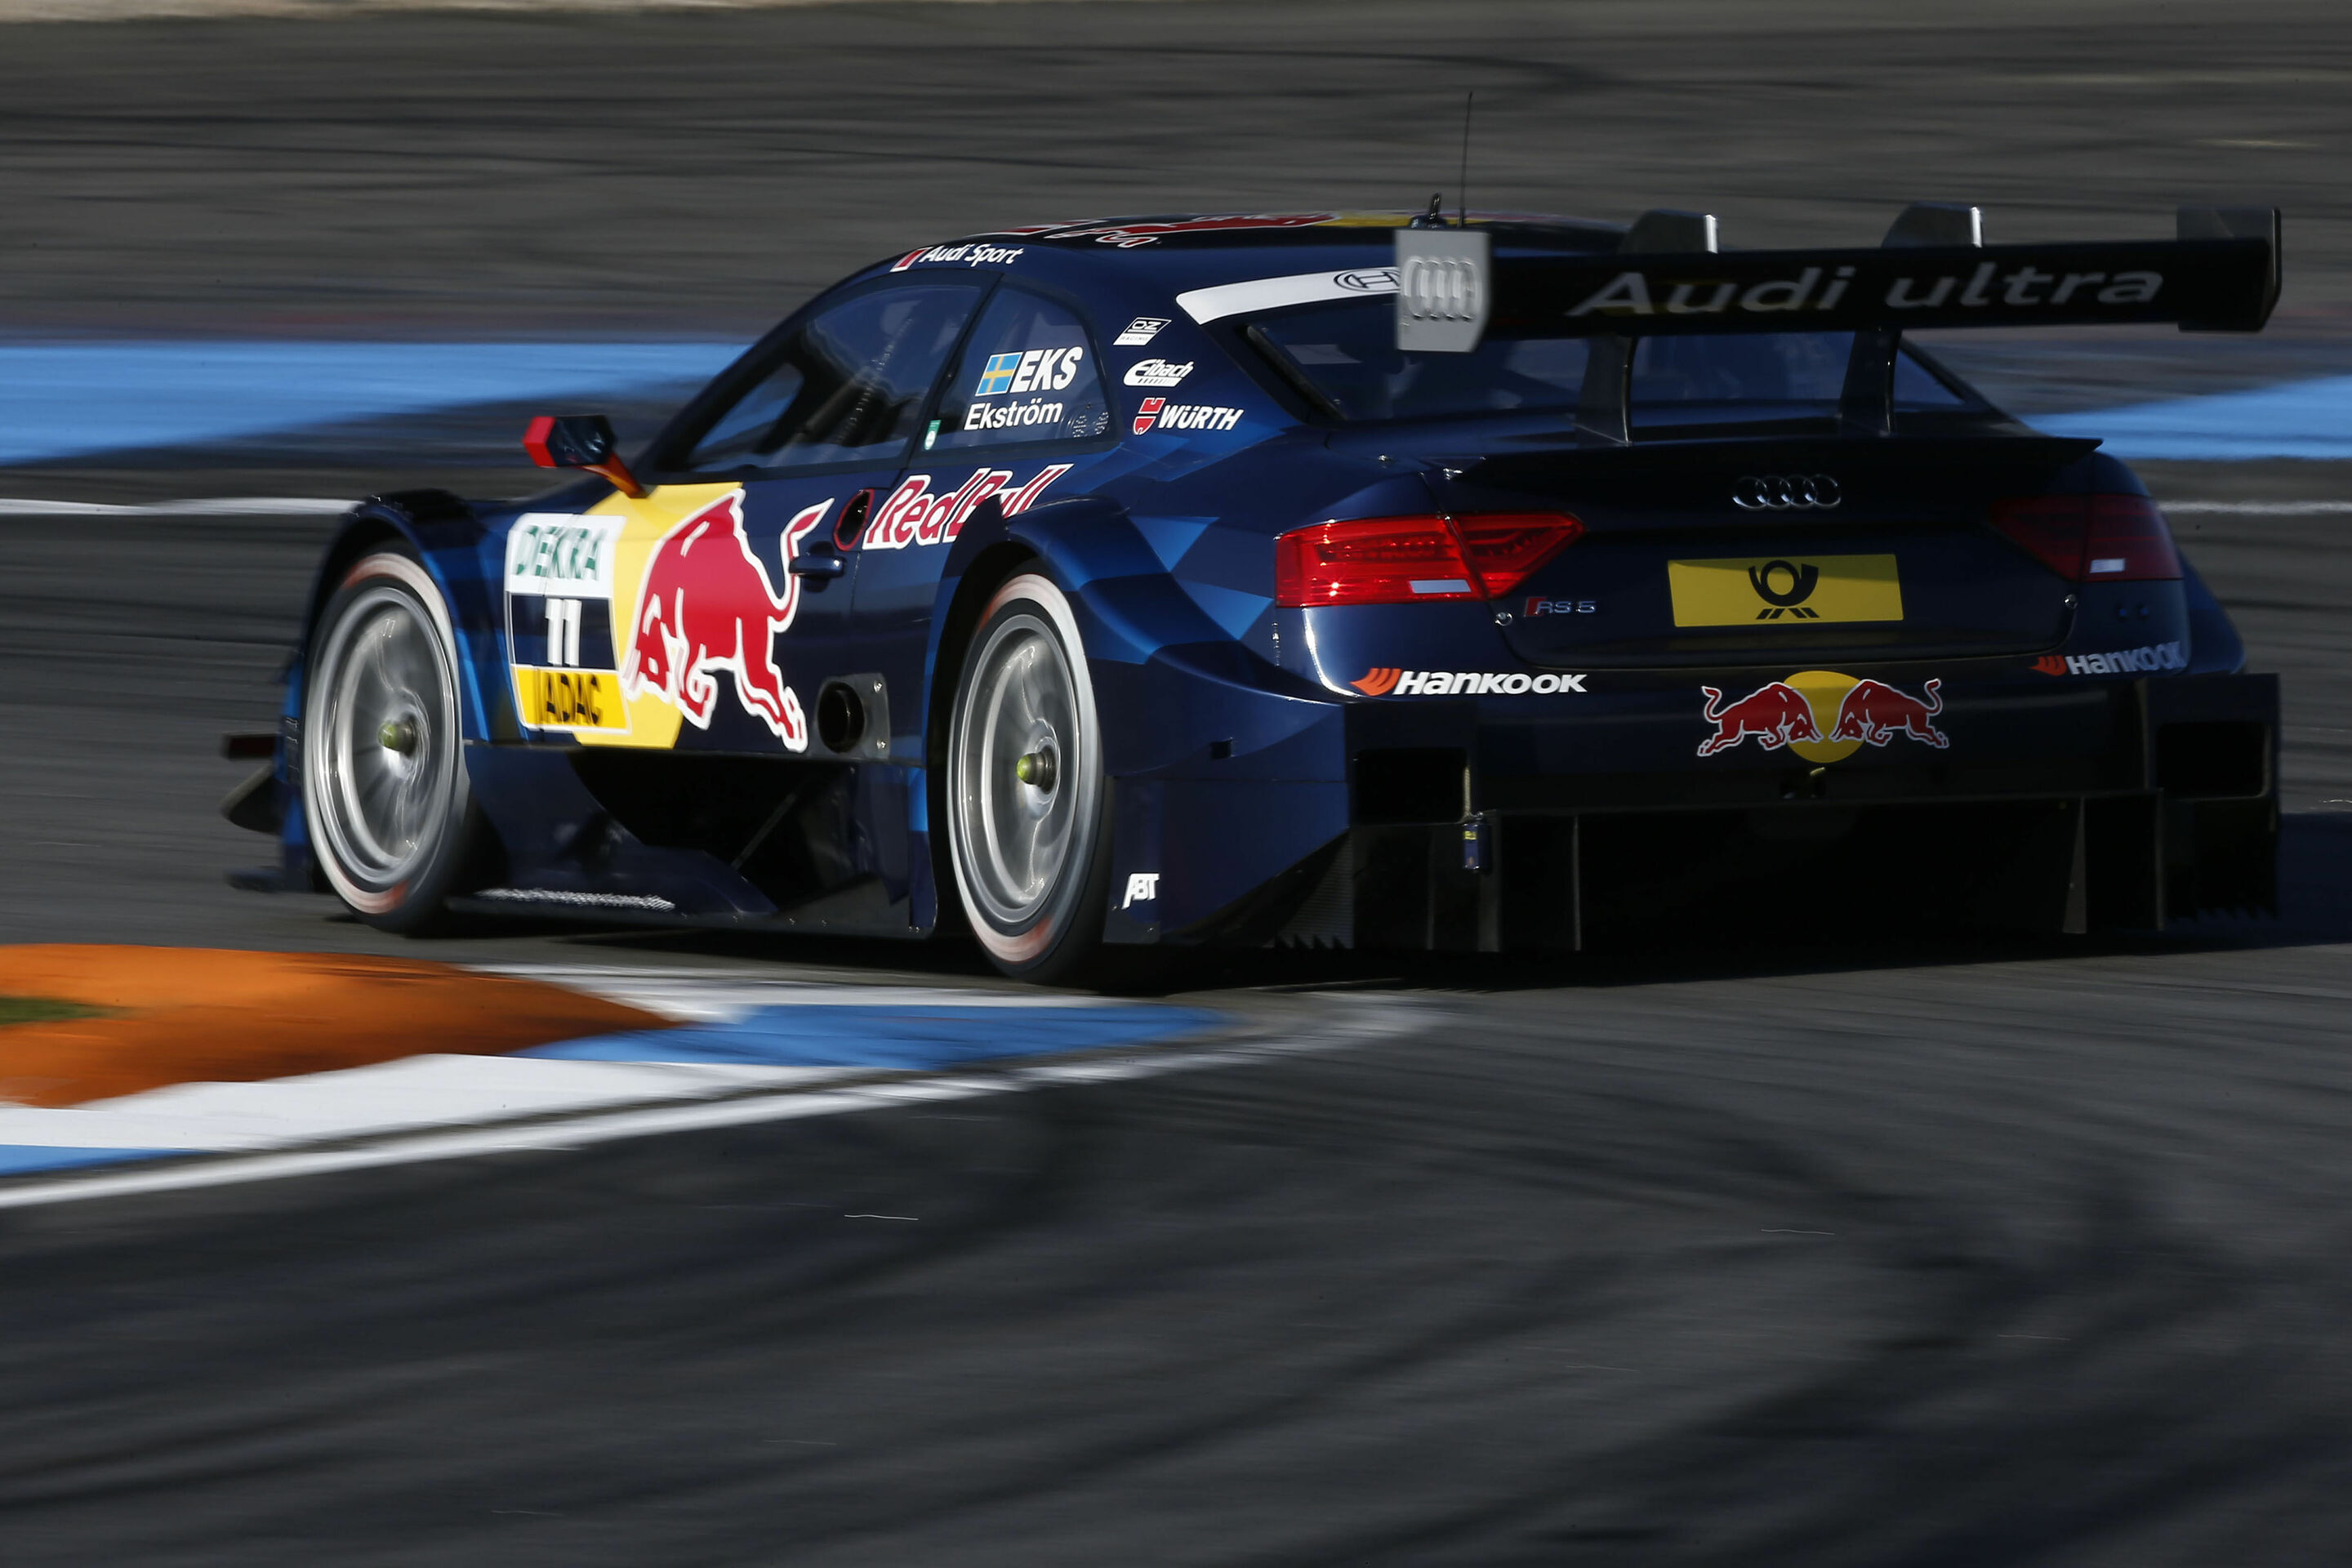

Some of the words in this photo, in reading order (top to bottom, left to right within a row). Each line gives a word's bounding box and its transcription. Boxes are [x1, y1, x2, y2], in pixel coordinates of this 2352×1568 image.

[918, 243, 975, 263] Audi
[964, 243, 1024, 267] Sport
[1563, 265, 1858, 317] Audi
[1883, 261, 2164, 311] ultra
[1132, 320, 1161, 330] OZ
[1009, 346, 1084, 394] EKS
[1124, 359, 1194, 387] Eibach
[964, 398, 1063, 431] Ekström
[1158, 405, 1244, 430] WÜRTH
[514, 524, 608, 581] DEKRA
[545, 598, 583, 668] 11
[536, 671, 603, 726] ADAC
[1121, 873, 1160, 910] ABT
